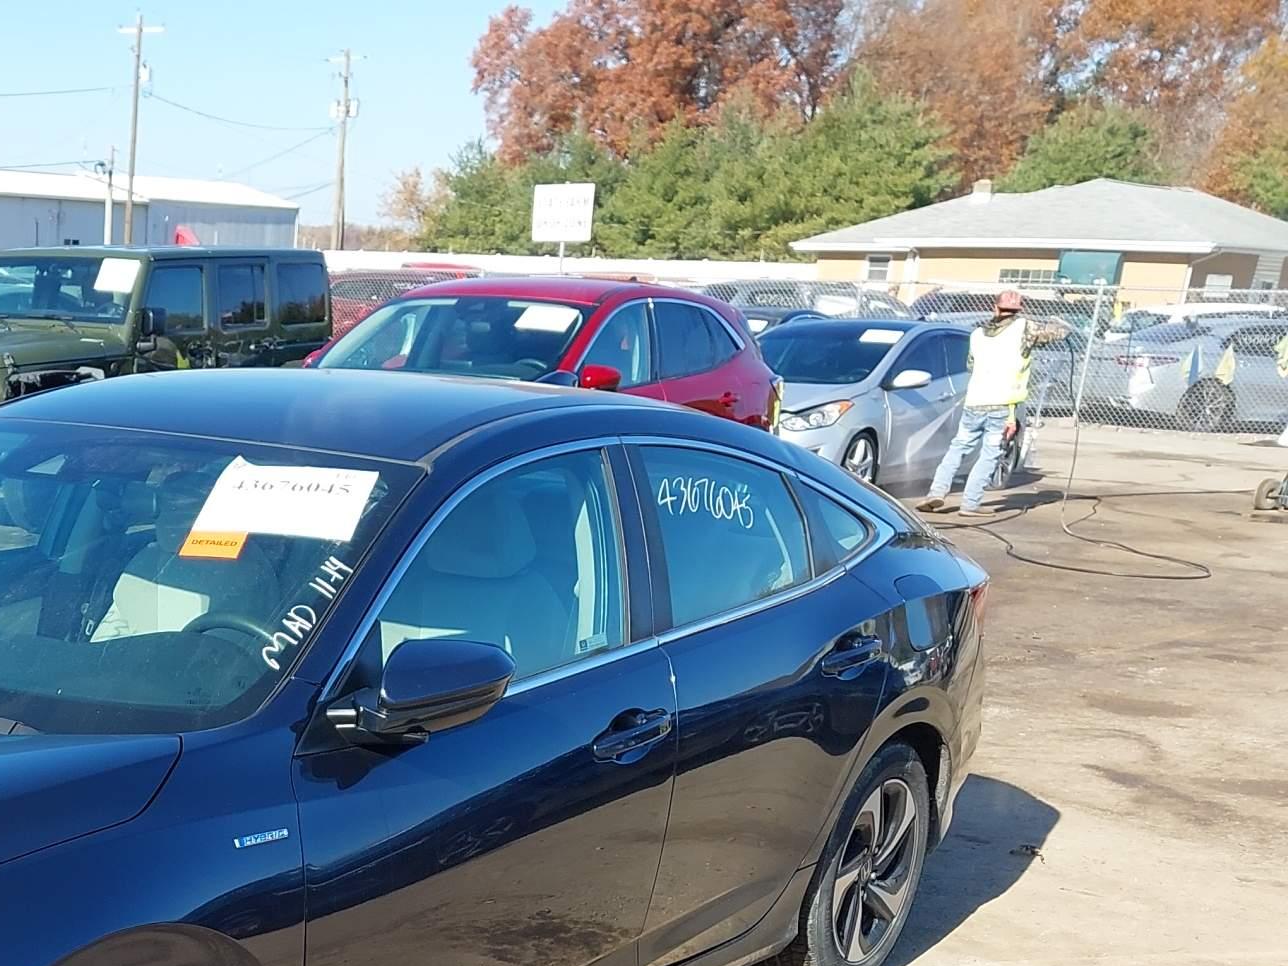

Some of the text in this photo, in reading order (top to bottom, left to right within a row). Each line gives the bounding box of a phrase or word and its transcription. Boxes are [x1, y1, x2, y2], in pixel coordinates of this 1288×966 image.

[657, 477, 754, 529] 43676045
[191, 539, 238, 547] DETAILED
[262, 555, 353, 670] MAD 11-14
